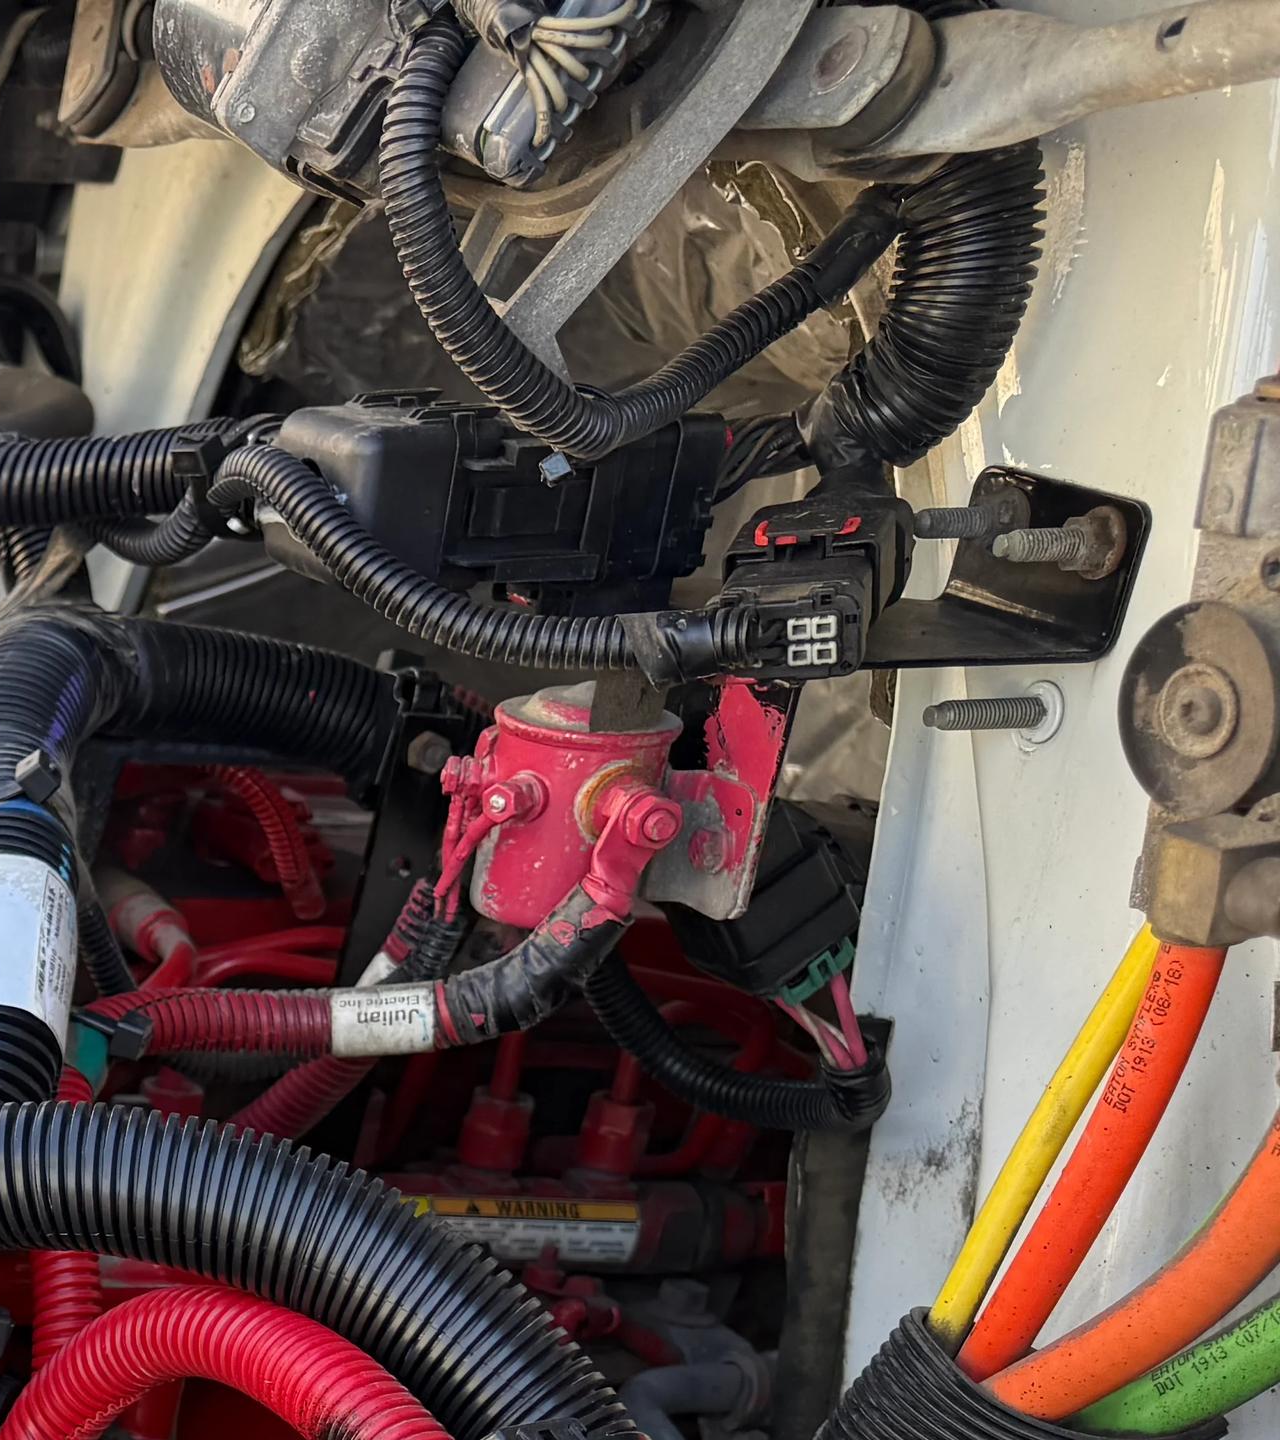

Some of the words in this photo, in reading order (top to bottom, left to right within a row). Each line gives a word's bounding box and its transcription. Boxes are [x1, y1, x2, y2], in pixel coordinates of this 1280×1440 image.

[338, 999, 361, 1008] Inc
[366, 995, 420, 1006] Electric
[357, 1009, 419, 1026] Julian
[1103, 1056, 1130, 1106] EATON
[1113, 1083, 1136, 1114] DOT
[496, 1199, 579, 1219] WARNING
[1152, 1370, 1184, 1396] DOT
[1191, 1345, 1227, 1374] 1913
